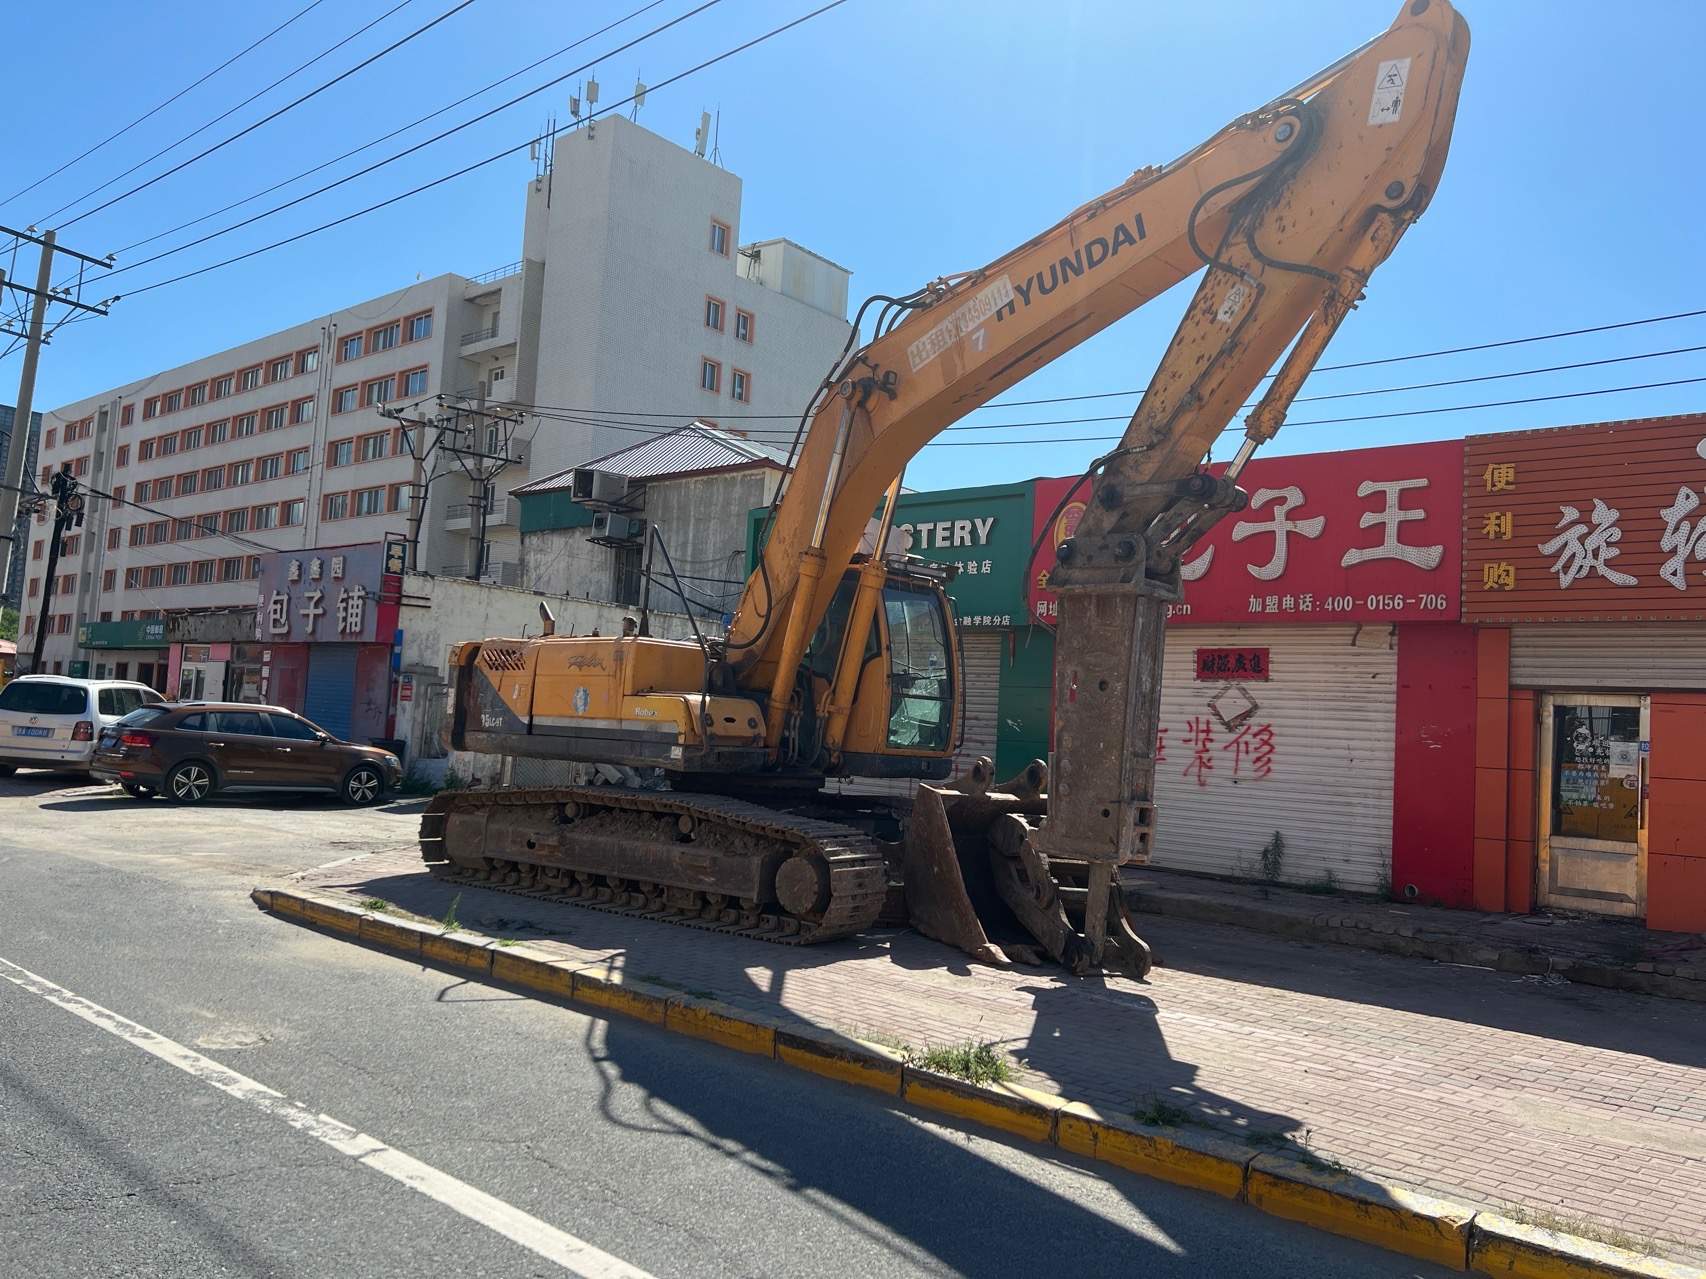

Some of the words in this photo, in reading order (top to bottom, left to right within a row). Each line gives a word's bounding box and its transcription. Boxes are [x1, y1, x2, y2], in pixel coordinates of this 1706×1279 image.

[1483, 462, 1516, 590] 便利购
[267, 584, 366, 634] 包子铺
